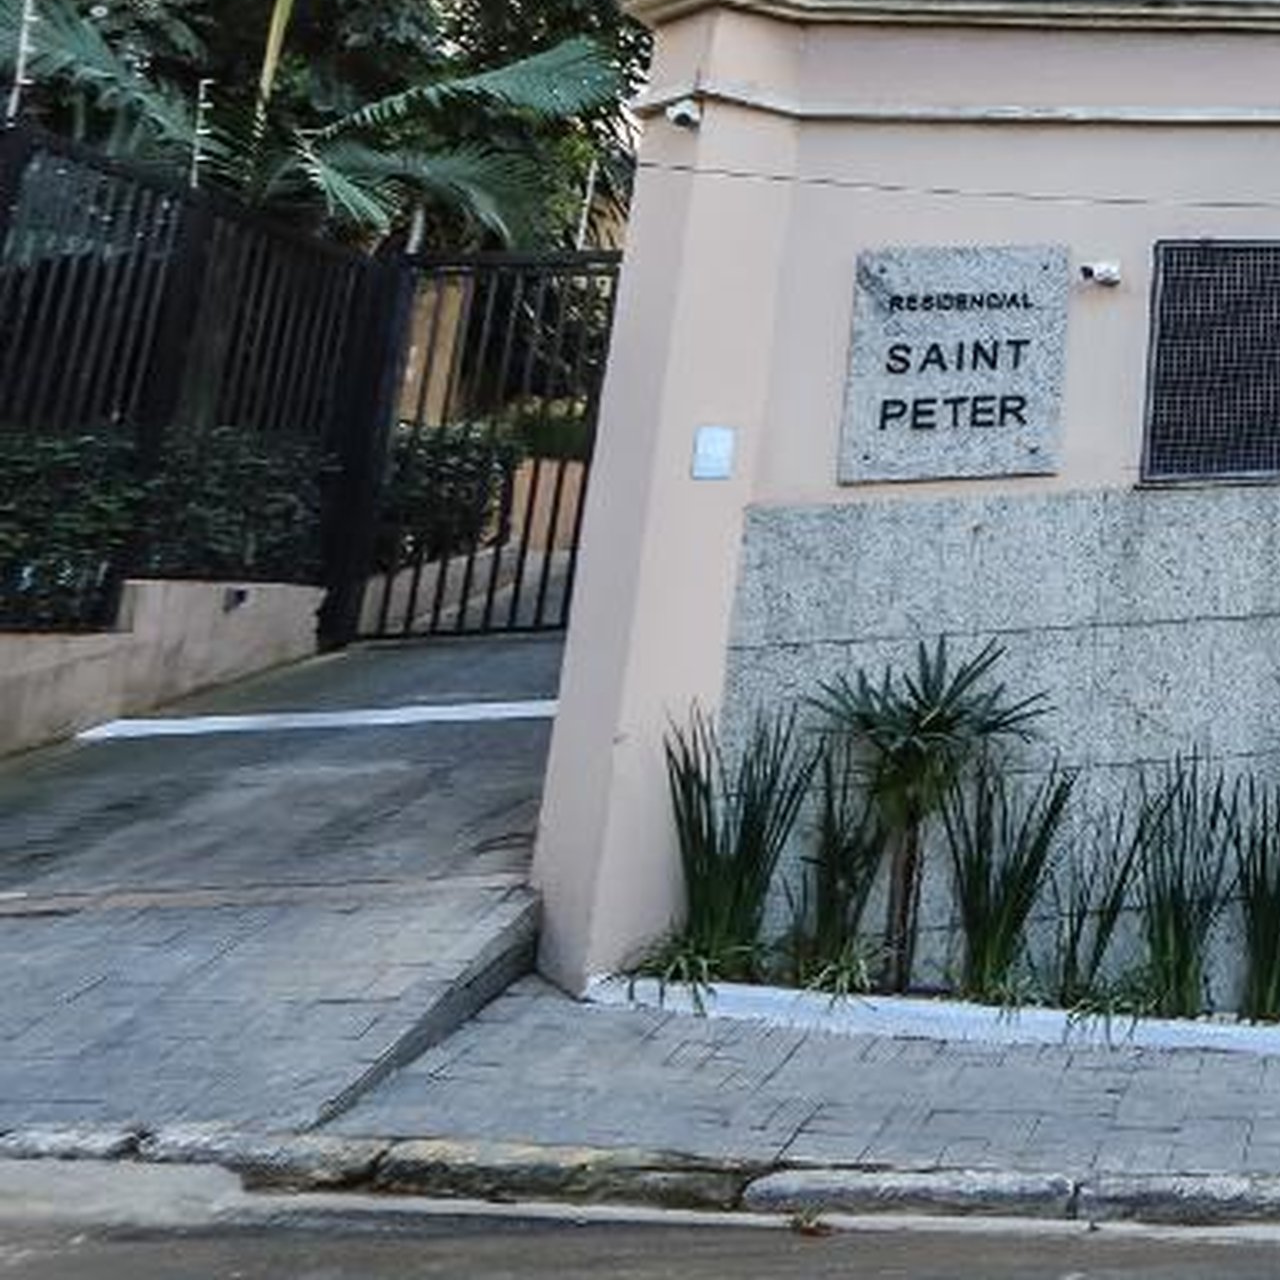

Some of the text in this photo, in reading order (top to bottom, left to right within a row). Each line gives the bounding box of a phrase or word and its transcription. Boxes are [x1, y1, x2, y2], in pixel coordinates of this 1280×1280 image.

[889, 292, 1035, 312] RESIDENCIAL
[885, 338, 1031, 375] SAINT
[878, 395, 1029, 432] PETER
